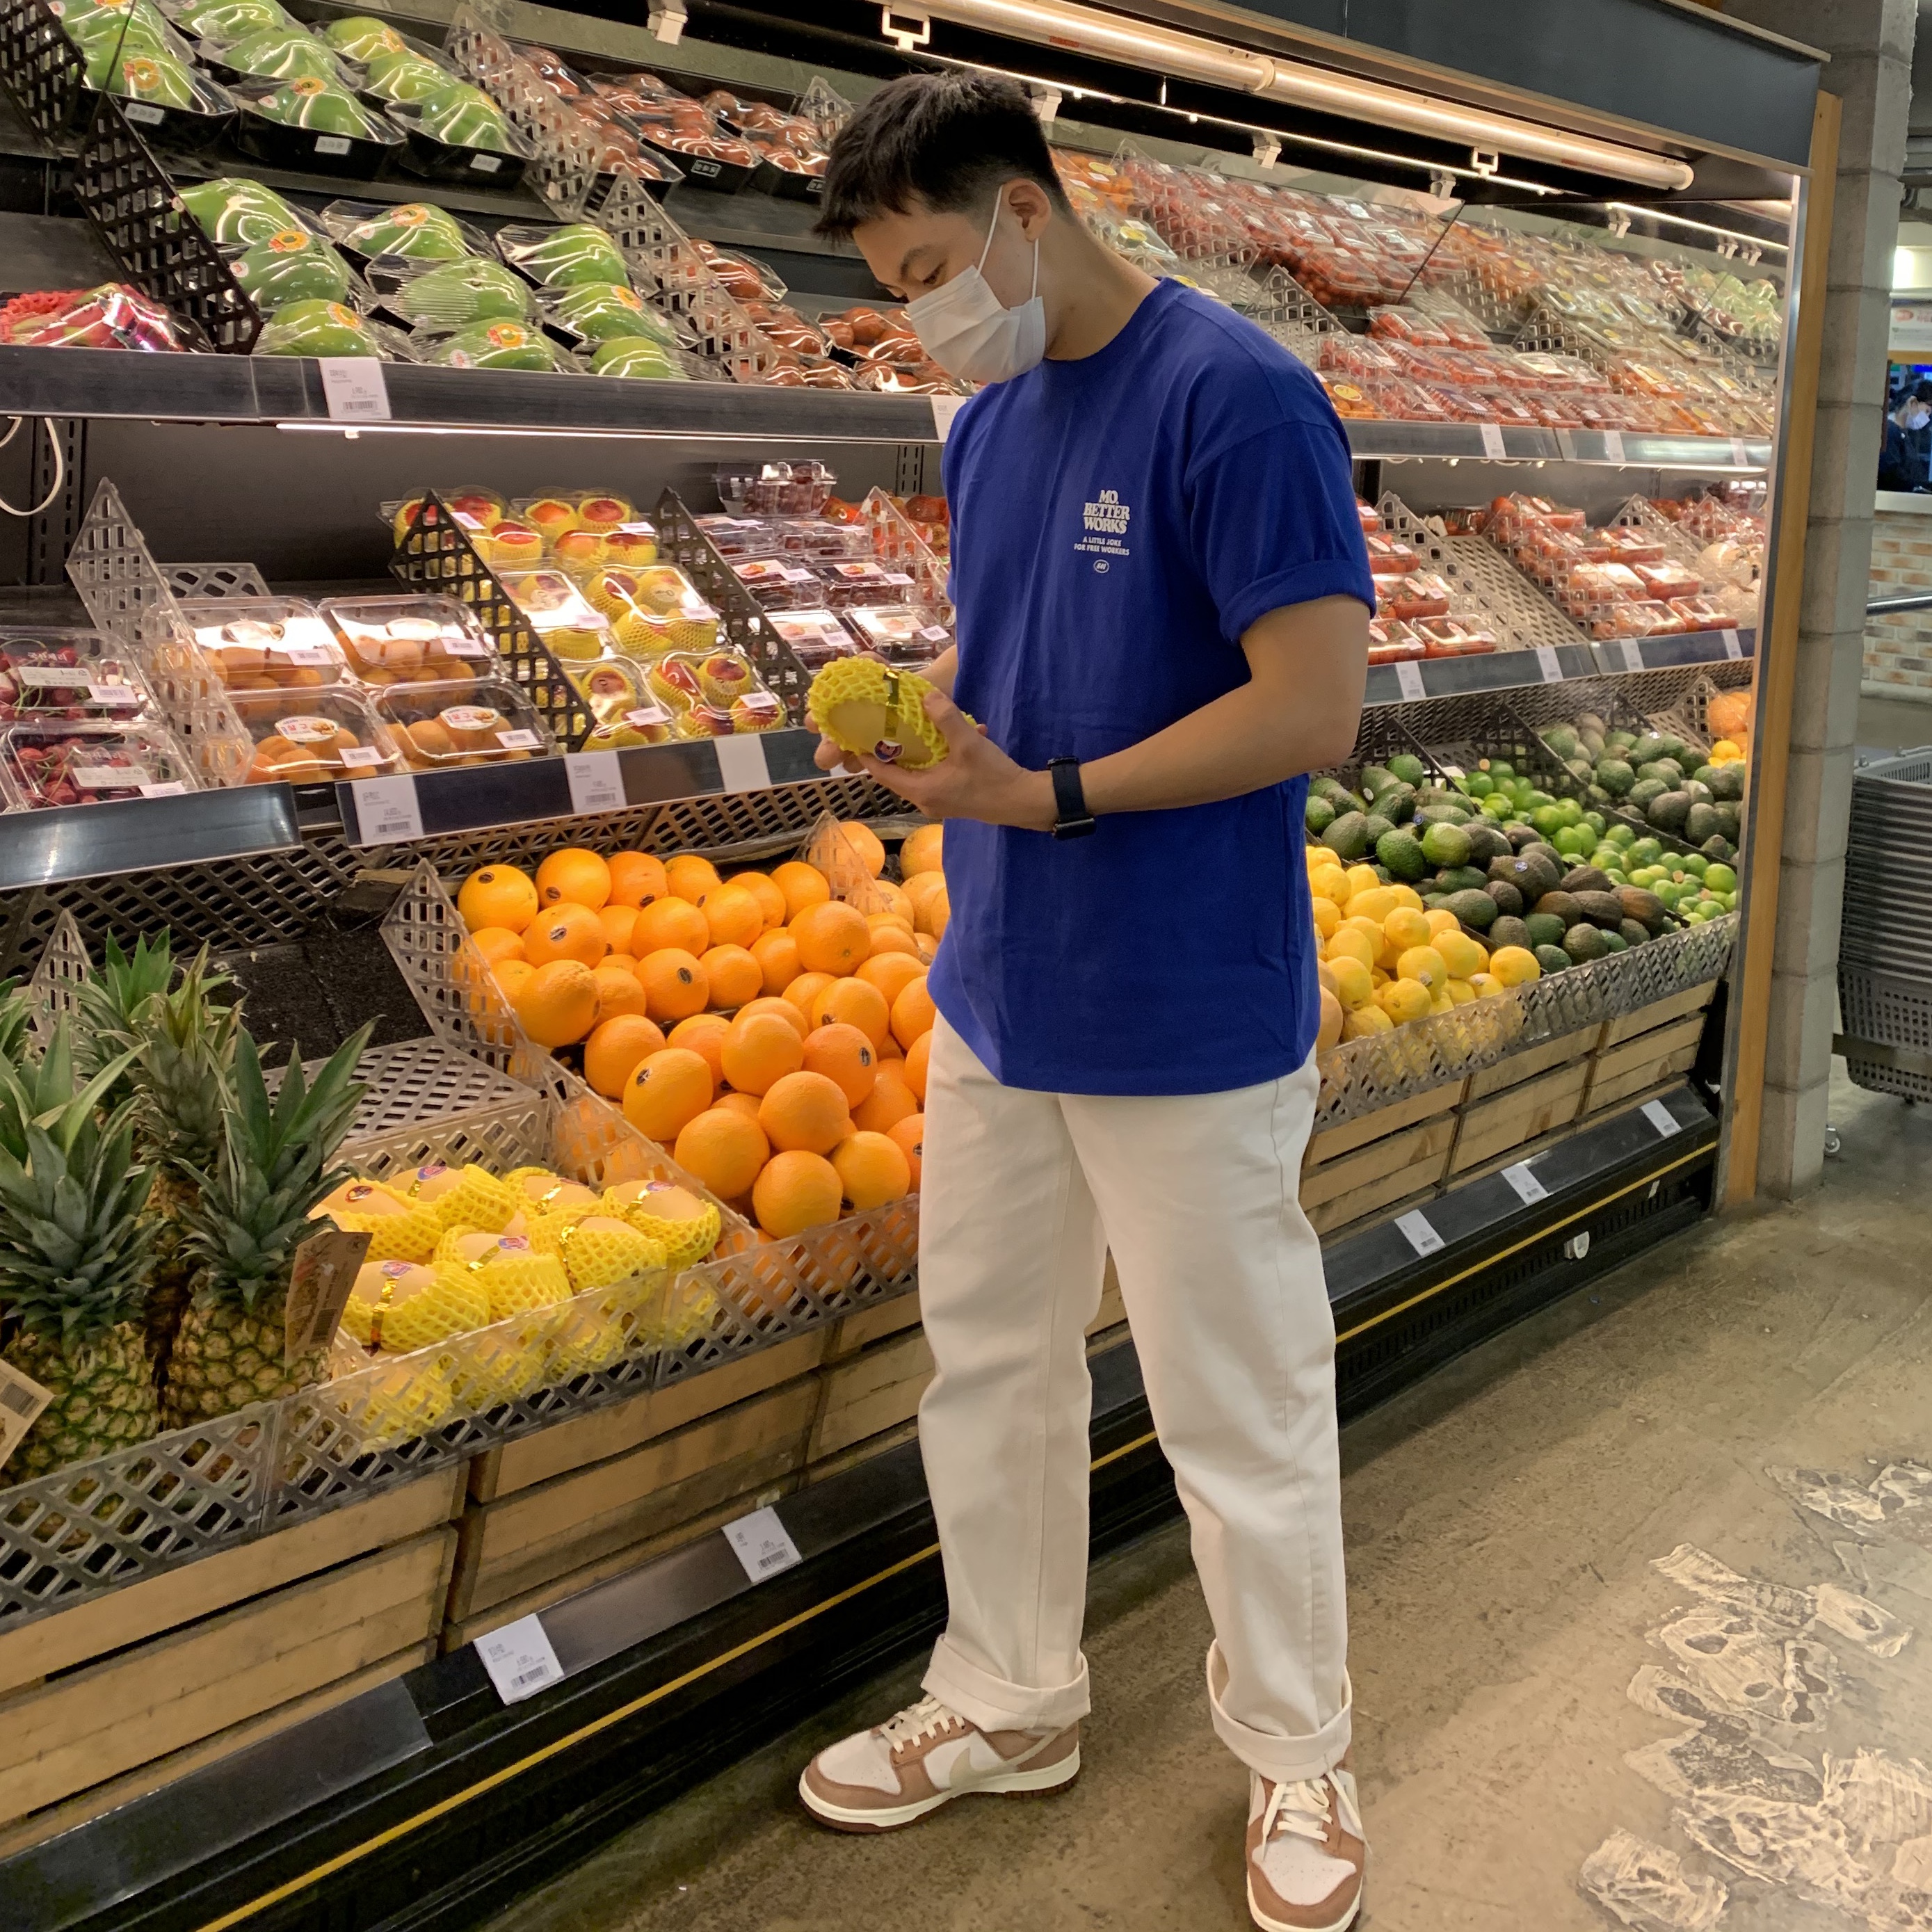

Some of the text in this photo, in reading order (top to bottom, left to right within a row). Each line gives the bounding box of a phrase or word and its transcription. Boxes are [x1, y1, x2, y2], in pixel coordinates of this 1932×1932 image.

[1083, 502, 1129, 520] BETTER
[1084, 517, 1127, 534] WORKS
[1101, 546, 1129, 556] WORKERS
